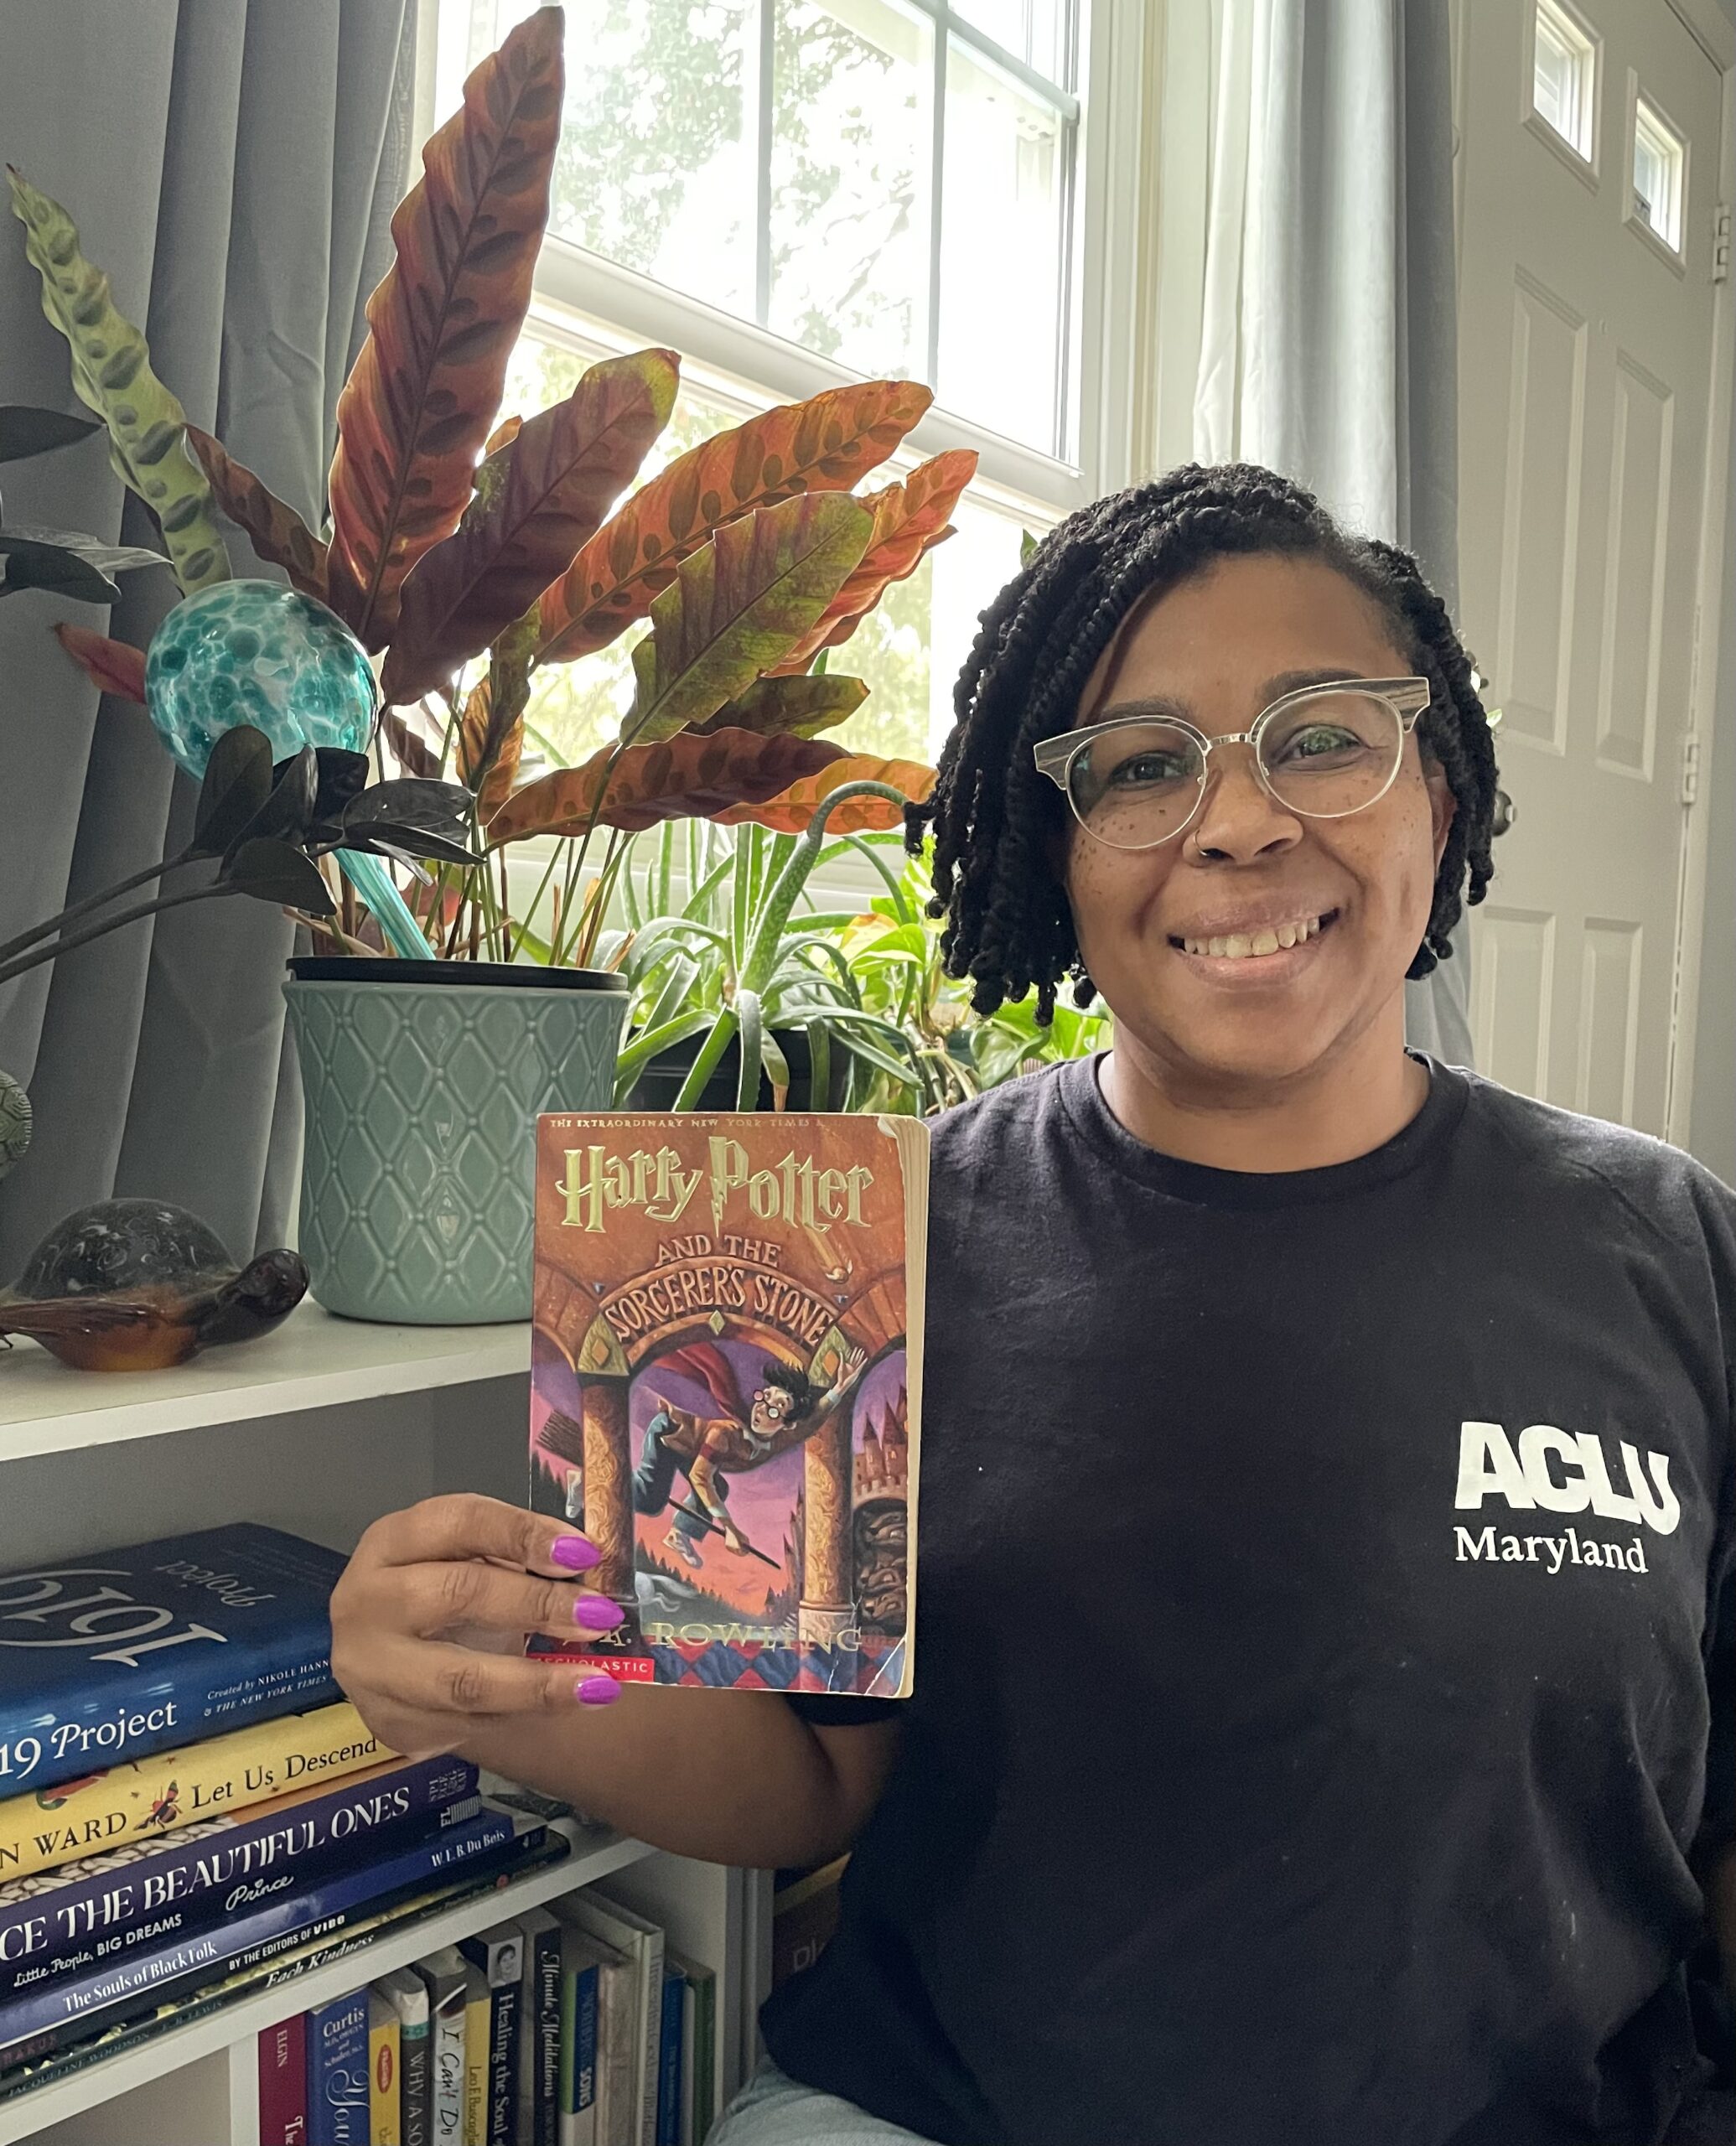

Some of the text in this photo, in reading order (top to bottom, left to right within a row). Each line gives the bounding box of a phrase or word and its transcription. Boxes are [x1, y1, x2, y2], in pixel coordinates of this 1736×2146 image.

[550, 1119, 572, 1128] THE
[577, 1118, 684, 1128] EXTRAORDINARY
[692, 1119, 718, 1128] NEW
[727, 1118, 762, 1127] YORK
[770, 1119, 811, 1127] TIMES
[555, 1136, 873, 1237] Harry Potter
[655, 1236, 781, 1267] AND THE
[604, 1262, 835, 1345] SORCERER'S STONE
[1454, 1421, 1681, 1535] ACLU
[1453, 1526, 1649, 1574] Maryland
[154, 1560, 277, 1607] Project
[651, 1621, 863, 1654] ROWLING
[207, 1682, 242, 1700] Created
[245, 1680, 256, 1692] by
[257, 1668, 297, 1685] NIKOLE
[216, 1700, 237, 1713] THE
[241, 1692, 265, 1707] NEW
[267, 1684, 294, 1699] YORK
[297, 1674, 328, 1690] TIMES
[51, 1702, 177, 1759] Project
[34, 1812, 127, 1857] WARD
[191, 1782, 233, 1810] Let
[245, 1765, 274, 1791] Us
[284, 1737, 378, 1781] Descend
[57, 1885, 135, 1939] THE
[143, 1820, 326, 1911] BEAUTIFUL
[330, 1786, 411, 1840] ONES
[13, 1874, 295, 1987] Little People, BIG DREAMS Prince
[63, 1991, 92, 2012] The
[94, 1975, 132, 2002] Souls
[133, 1964, 151, 1986] of
[151, 1954, 188, 1980] Black
[189, 1941, 219, 1966] Folk
[467, 1840, 482, 1853] Du
[483, 1829, 506, 1848] Bois
[229, 1957, 241, 1971] BY
[243, 1950, 261, 1965] THE
[262, 1934, 299, 1957] EDITORS
[301, 1928, 314, 1941] OF
[89, 2032, 151, 2063] WOODSON
[266, 1961, 304, 1989] Each
[308, 1934, 376, 1970] Kindness
[541, 1951, 561, 2009] Minute
[323, 2007, 365, 2038] Curtis
[491, 1991, 515, 2064] Healing
[407, 2050, 426, 2097] WHY
[469, 2066, 482, 2088] Leo
[495, 2065, 512, 2094] the
[541, 2010, 562, 2097] Meditations
[277, 2029, 304, 2146] ELGIN The
[440, 2028, 460, 2136] I Can't Do
[408, 2107, 423, 2118] A
[493, 2097, 510, 2136] Soul
